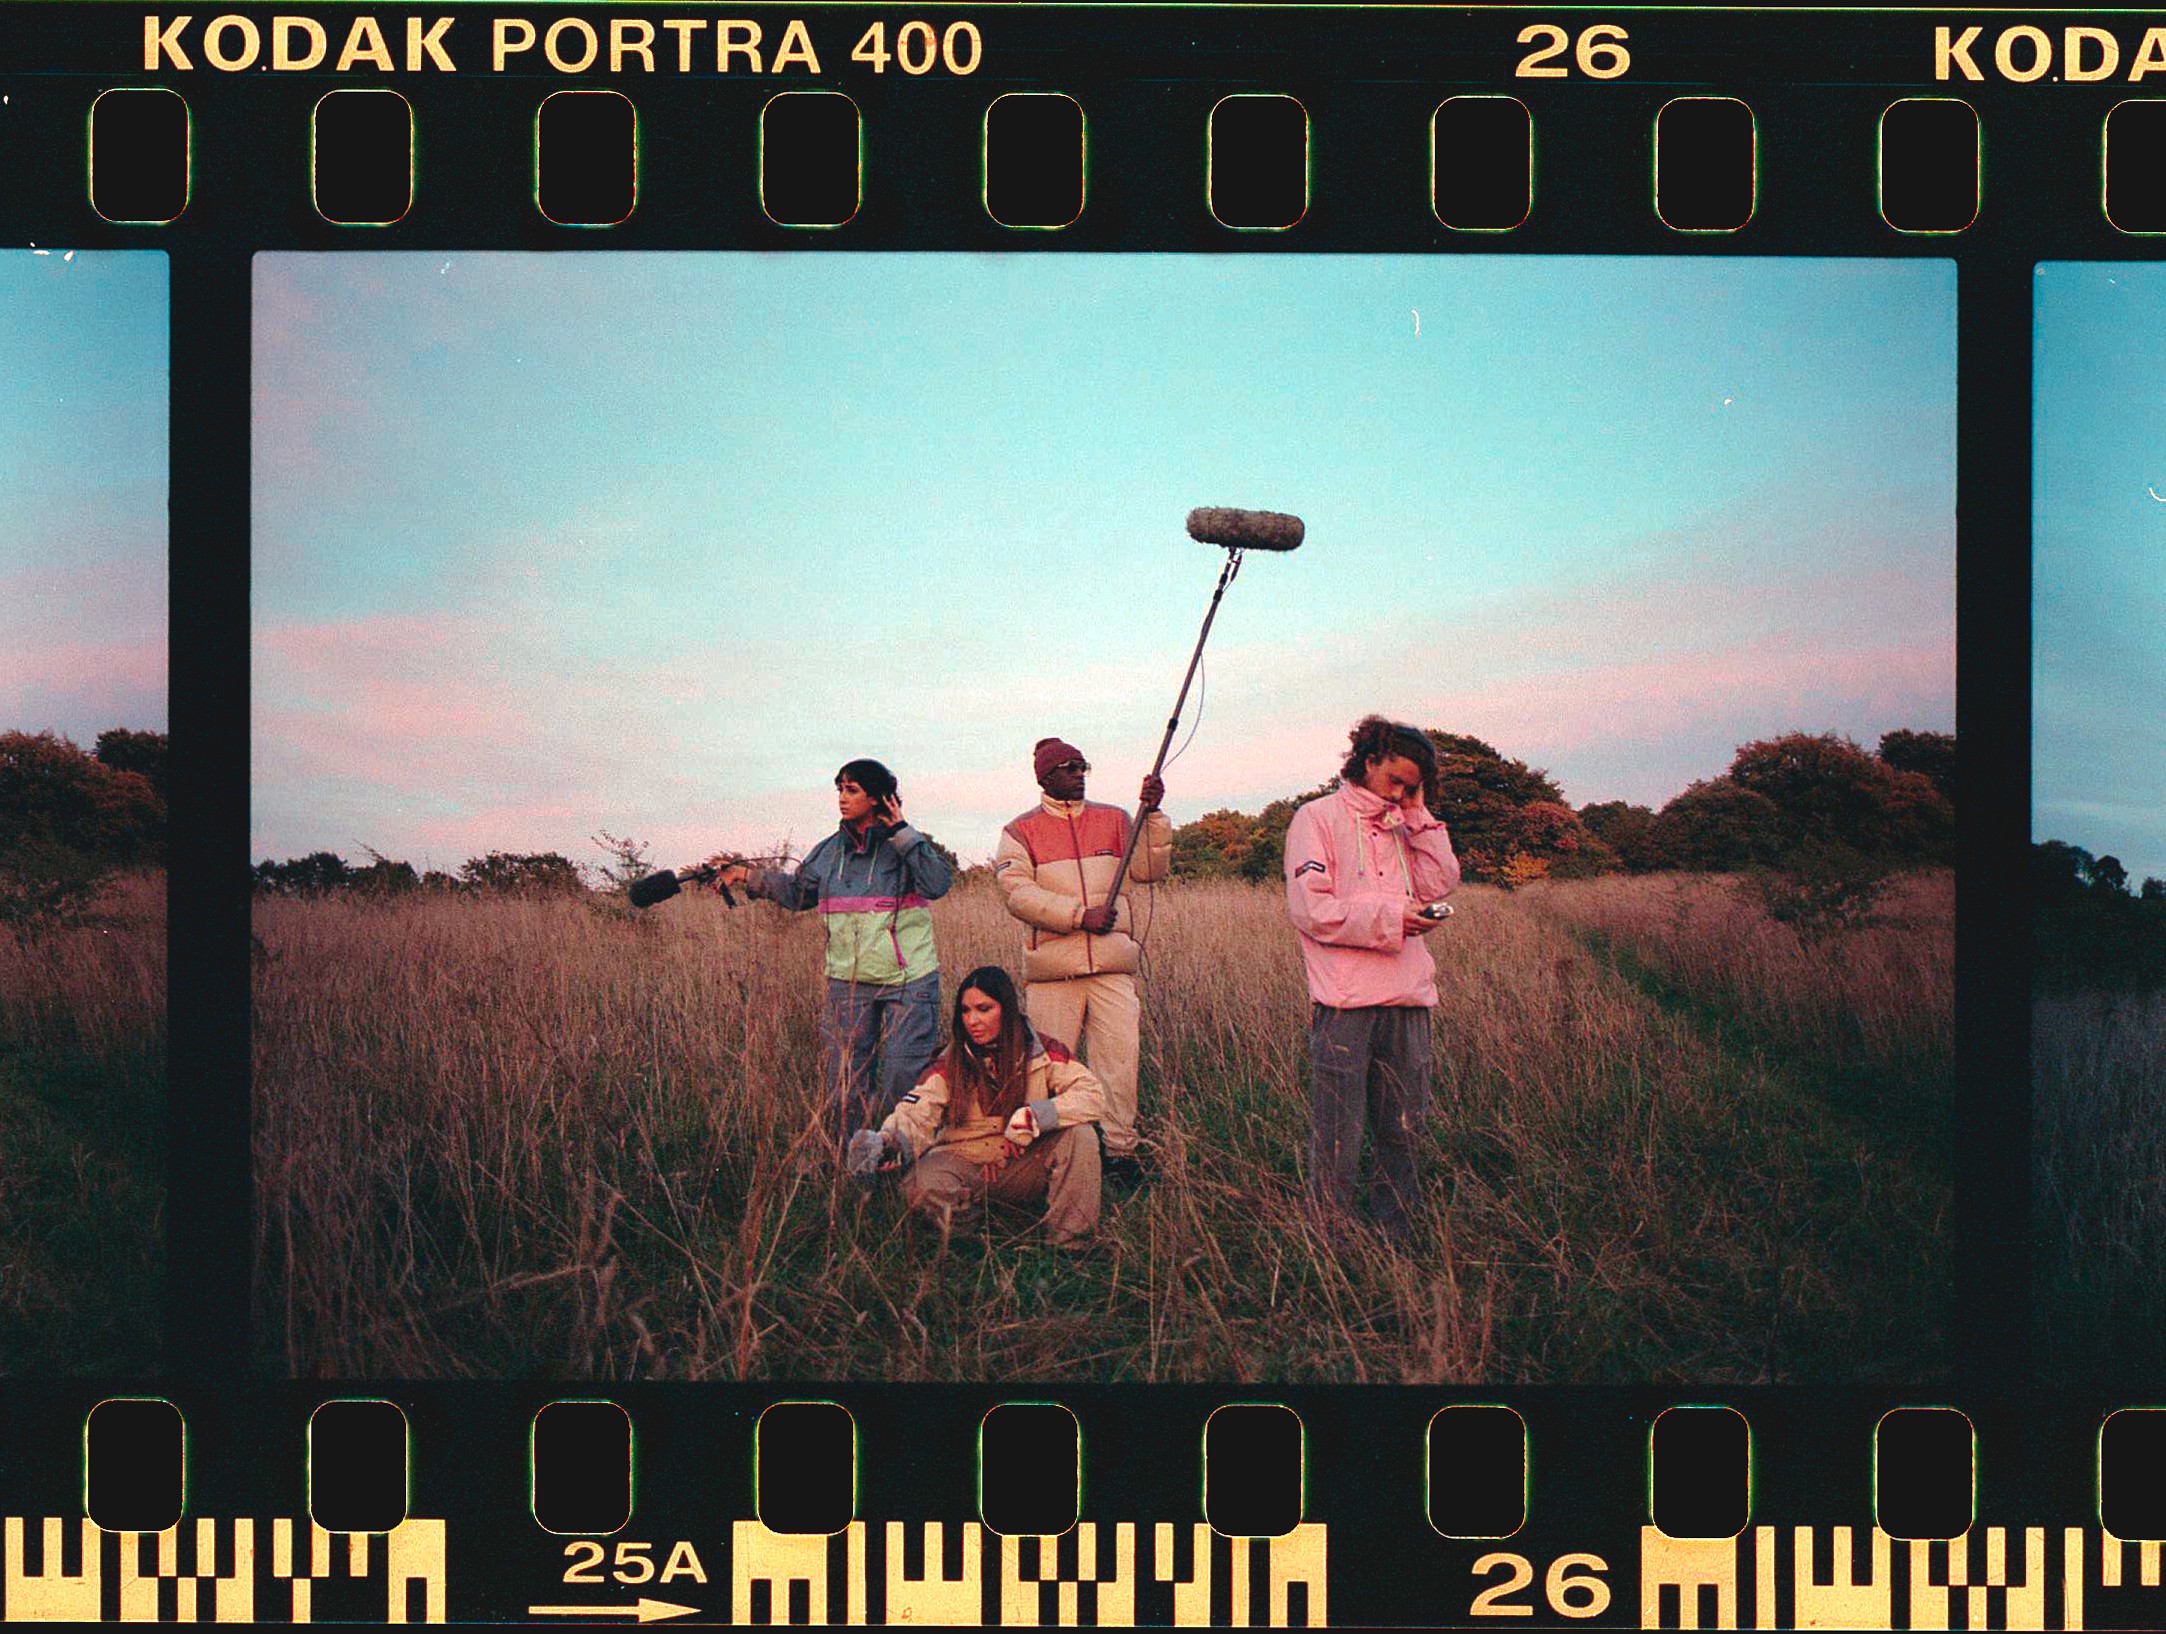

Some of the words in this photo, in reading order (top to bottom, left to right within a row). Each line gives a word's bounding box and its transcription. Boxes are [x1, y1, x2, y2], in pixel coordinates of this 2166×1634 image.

[143, 15, 457, 74] KODAK
[492, 17, 821, 75] PORTRA
[851, 20, 983, 76] 400
[1514, 24, 1631, 79] 26
[562, 1540, 708, 1584] 25A
[1469, 1552, 1611, 1619] 26
